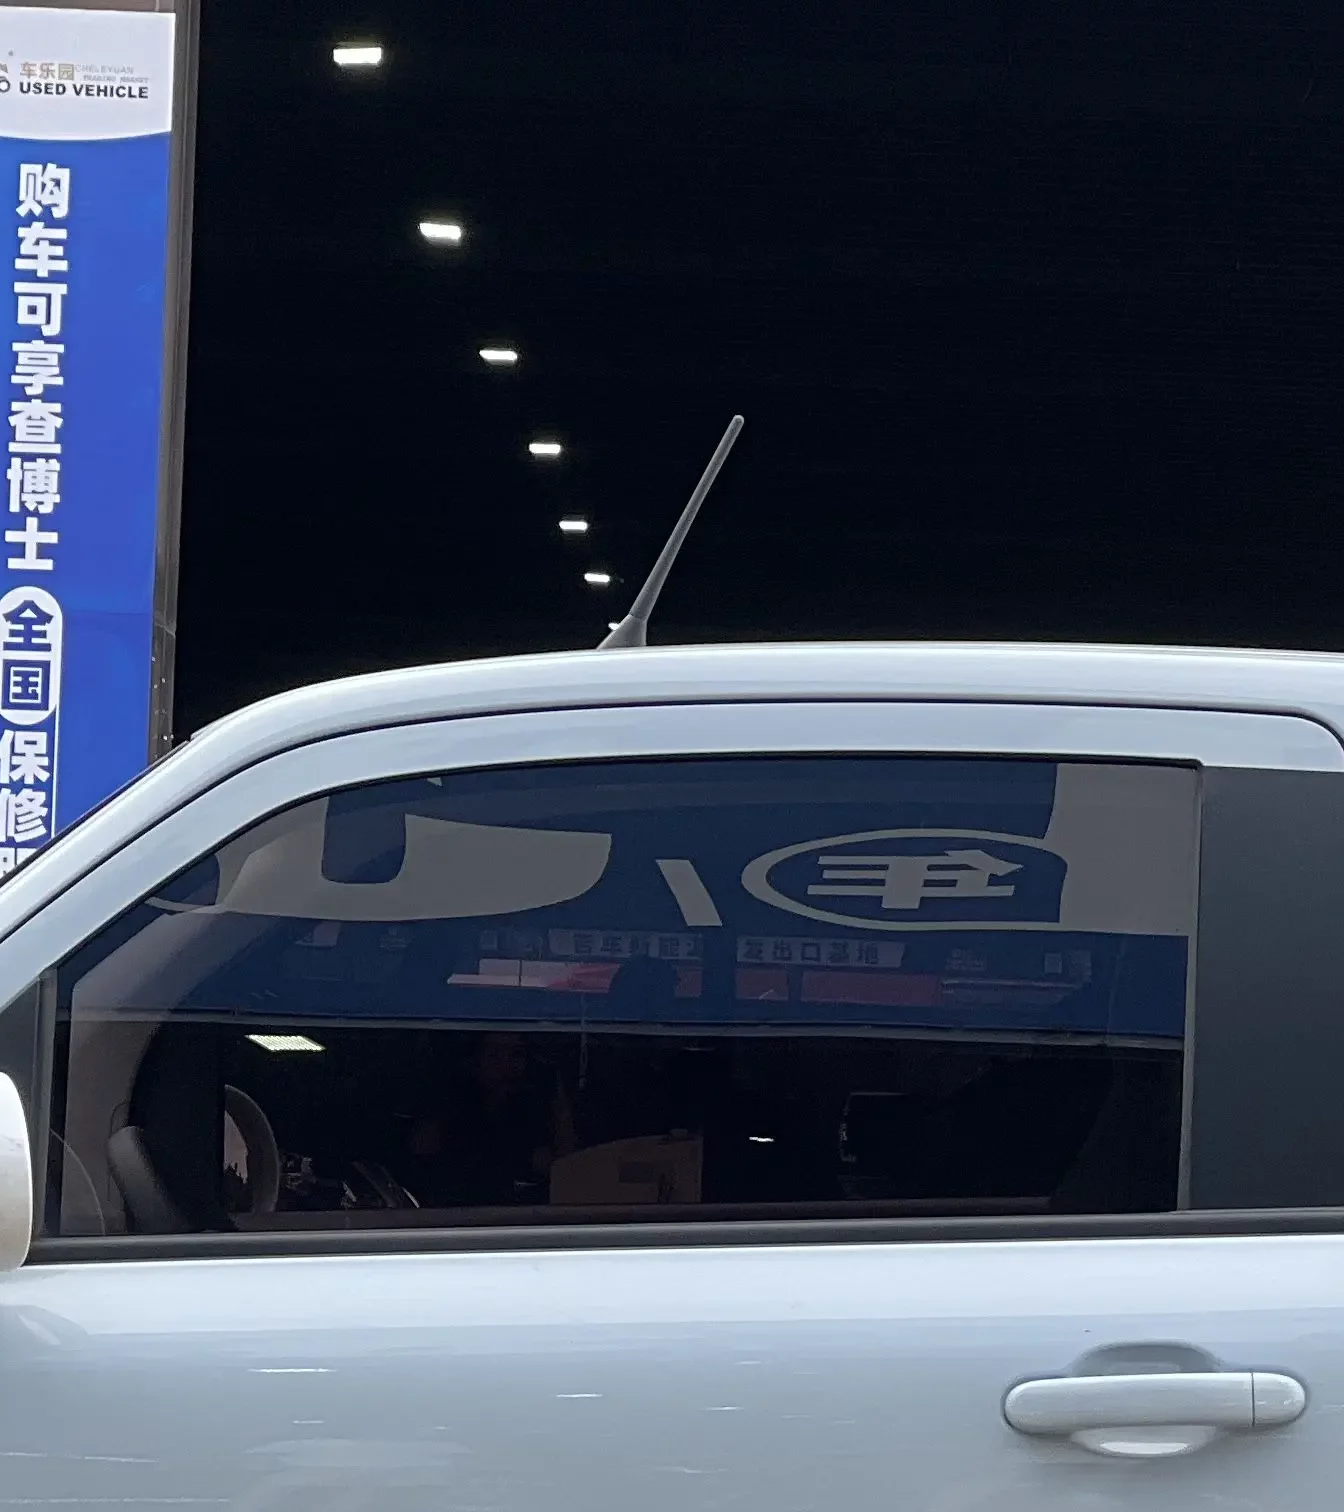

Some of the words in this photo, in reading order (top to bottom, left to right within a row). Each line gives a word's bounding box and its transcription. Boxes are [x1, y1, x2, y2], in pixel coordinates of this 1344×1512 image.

[19, 61, 75, 81] 车乐园
[19, 81, 67, 96] USED
[72, 84, 149, 99] VEHICLE
[4, 163, 70, 571] 购车可享查博士
